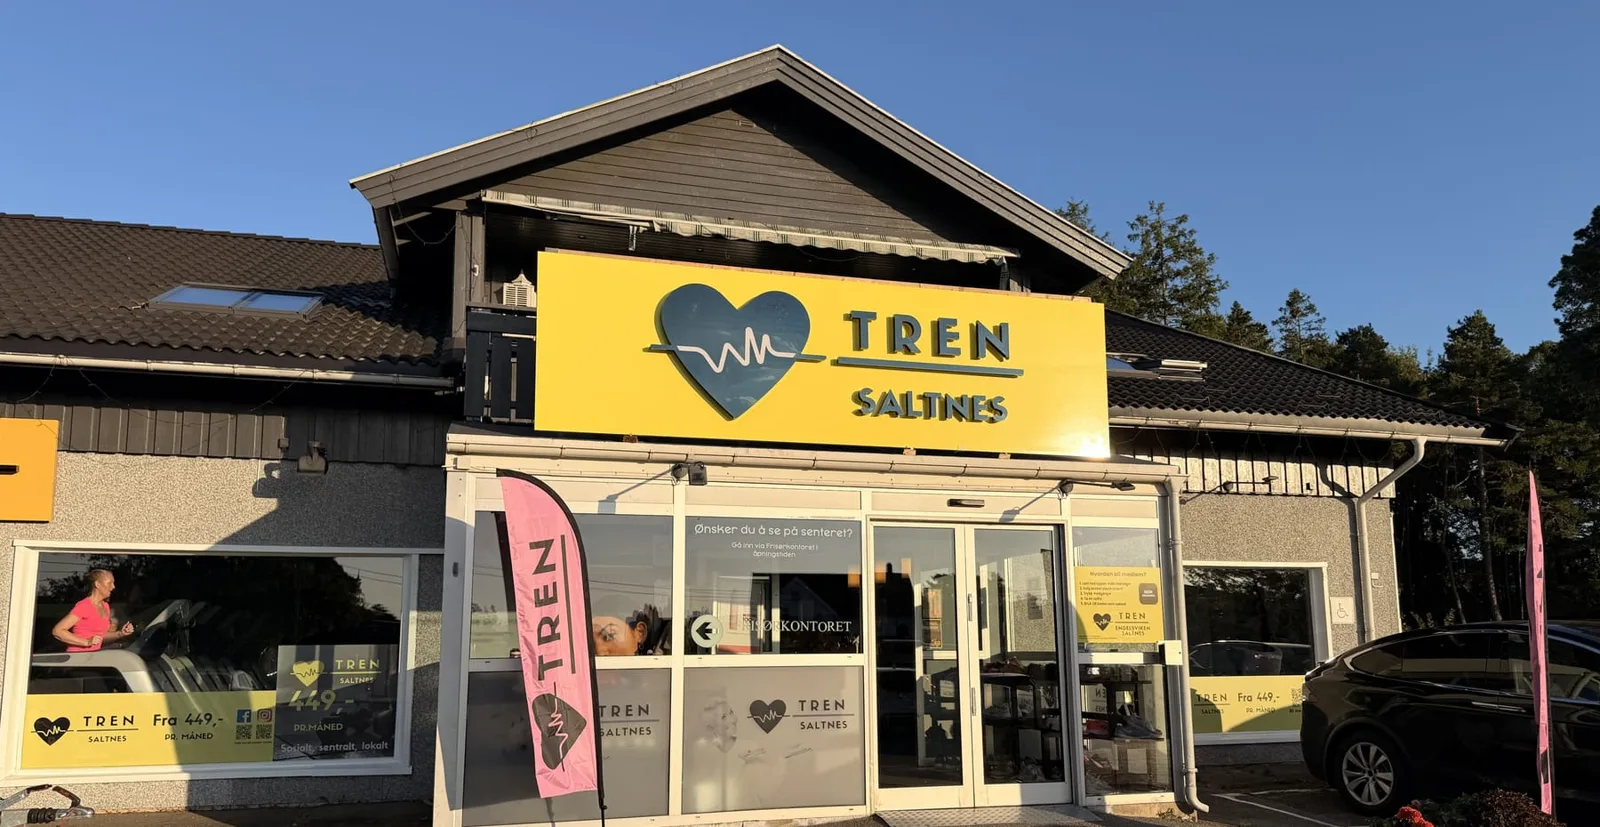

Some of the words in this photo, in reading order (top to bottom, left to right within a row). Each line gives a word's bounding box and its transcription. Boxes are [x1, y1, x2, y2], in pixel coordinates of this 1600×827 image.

[848, 310, 1010, 362] TREN
[854, 387, 1008, 423] SALTNES
[694, 524, 738, 535] Ønsker
[740, 525, 755, 535] du
[758, 525, 766, 535] å
[768, 528, 781, 536] se
[783, 526, 798, 537] på
[801, 527, 853, 538] senteret?
[529, 538, 563, 681] TREN
[1118, 612, 1146, 620] TREN
[737, 620, 852, 633] RISØRKONTORET
[335, 659, 379, 670] TREN
[1196, 693, 1227, 702] TREN
[1237, 692, 1253, 702] Fra
[1256, 692, 1280, 703] 449,-
[598, 704, 650, 717] TREN
[798, 699, 845, 711] TREN
[83, 715, 134, 727] TREN
[153, 714, 177, 726] Fra
[185, 713, 224, 727] 449,-
[800, 720, 848, 730] SALTNES
[88, 735, 127, 743] SALTNES
[181, 731, 214, 740] MÅNED
[281, 744, 315, 754] Sosialt,
[362, 741, 388, 750] lokalt
